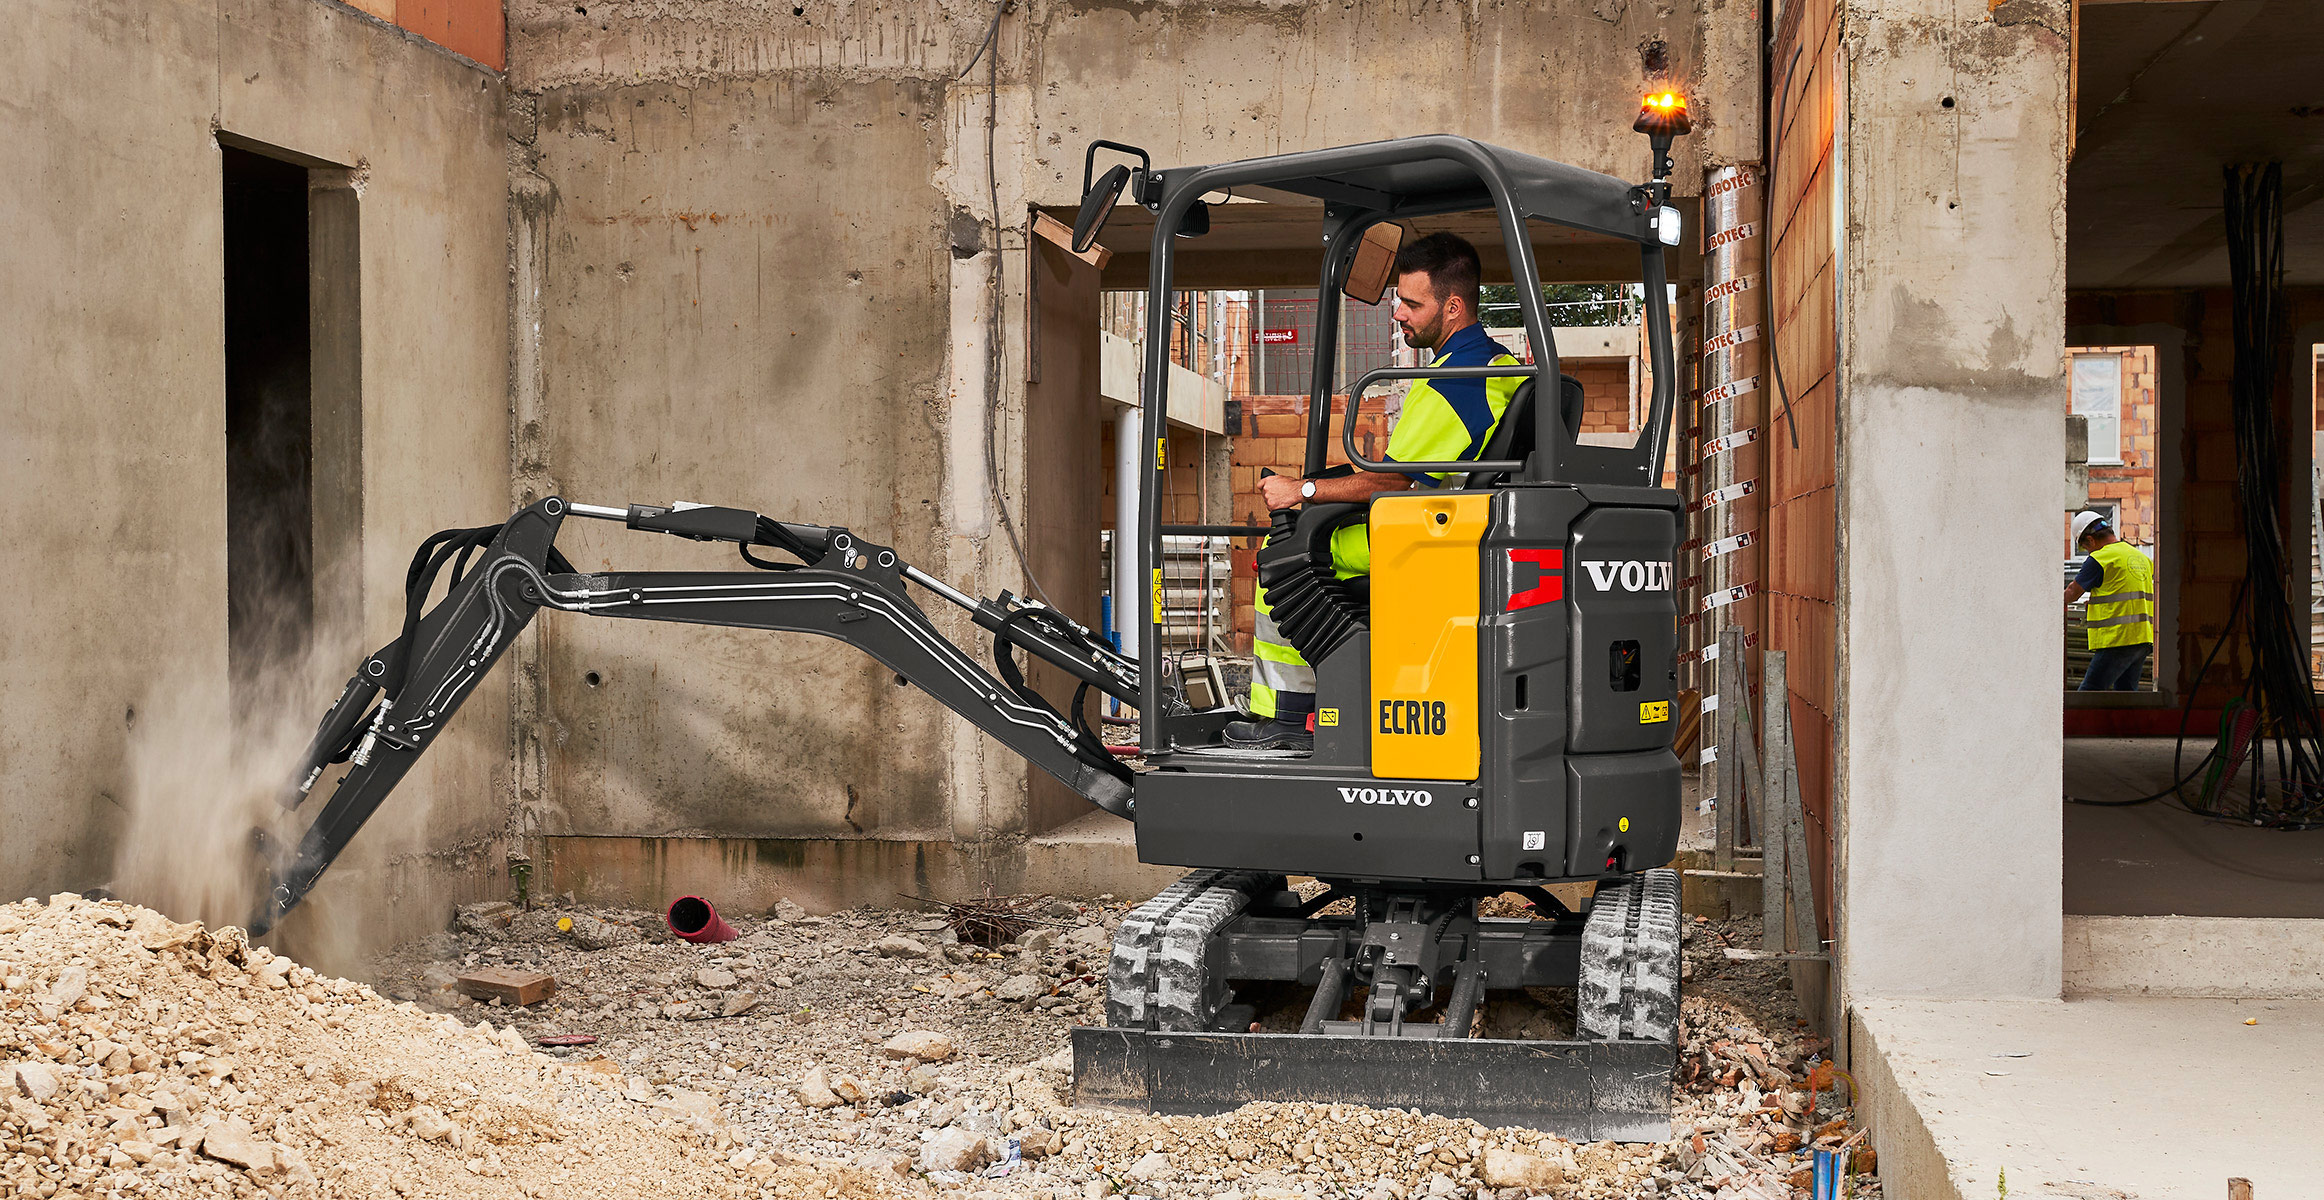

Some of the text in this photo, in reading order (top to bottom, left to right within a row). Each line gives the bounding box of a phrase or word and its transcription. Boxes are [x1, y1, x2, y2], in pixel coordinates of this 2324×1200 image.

[1708, 172, 1751, 198] UBOTEC
[1706, 226, 1746, 251] UBOTEC
[1705, 280, 1740, 303] BOTEC
[1704, 333, 1734, 355] BOTEC
[1703, 386, 1728, 407] OTEC
[1581, 561, 1673, 592] VOLV
[1677, 650, 1701, 664] BOTEC
[1380, 700, 1446, 735] ECR18
[1337, 787, 1433, 806] VOLVO
